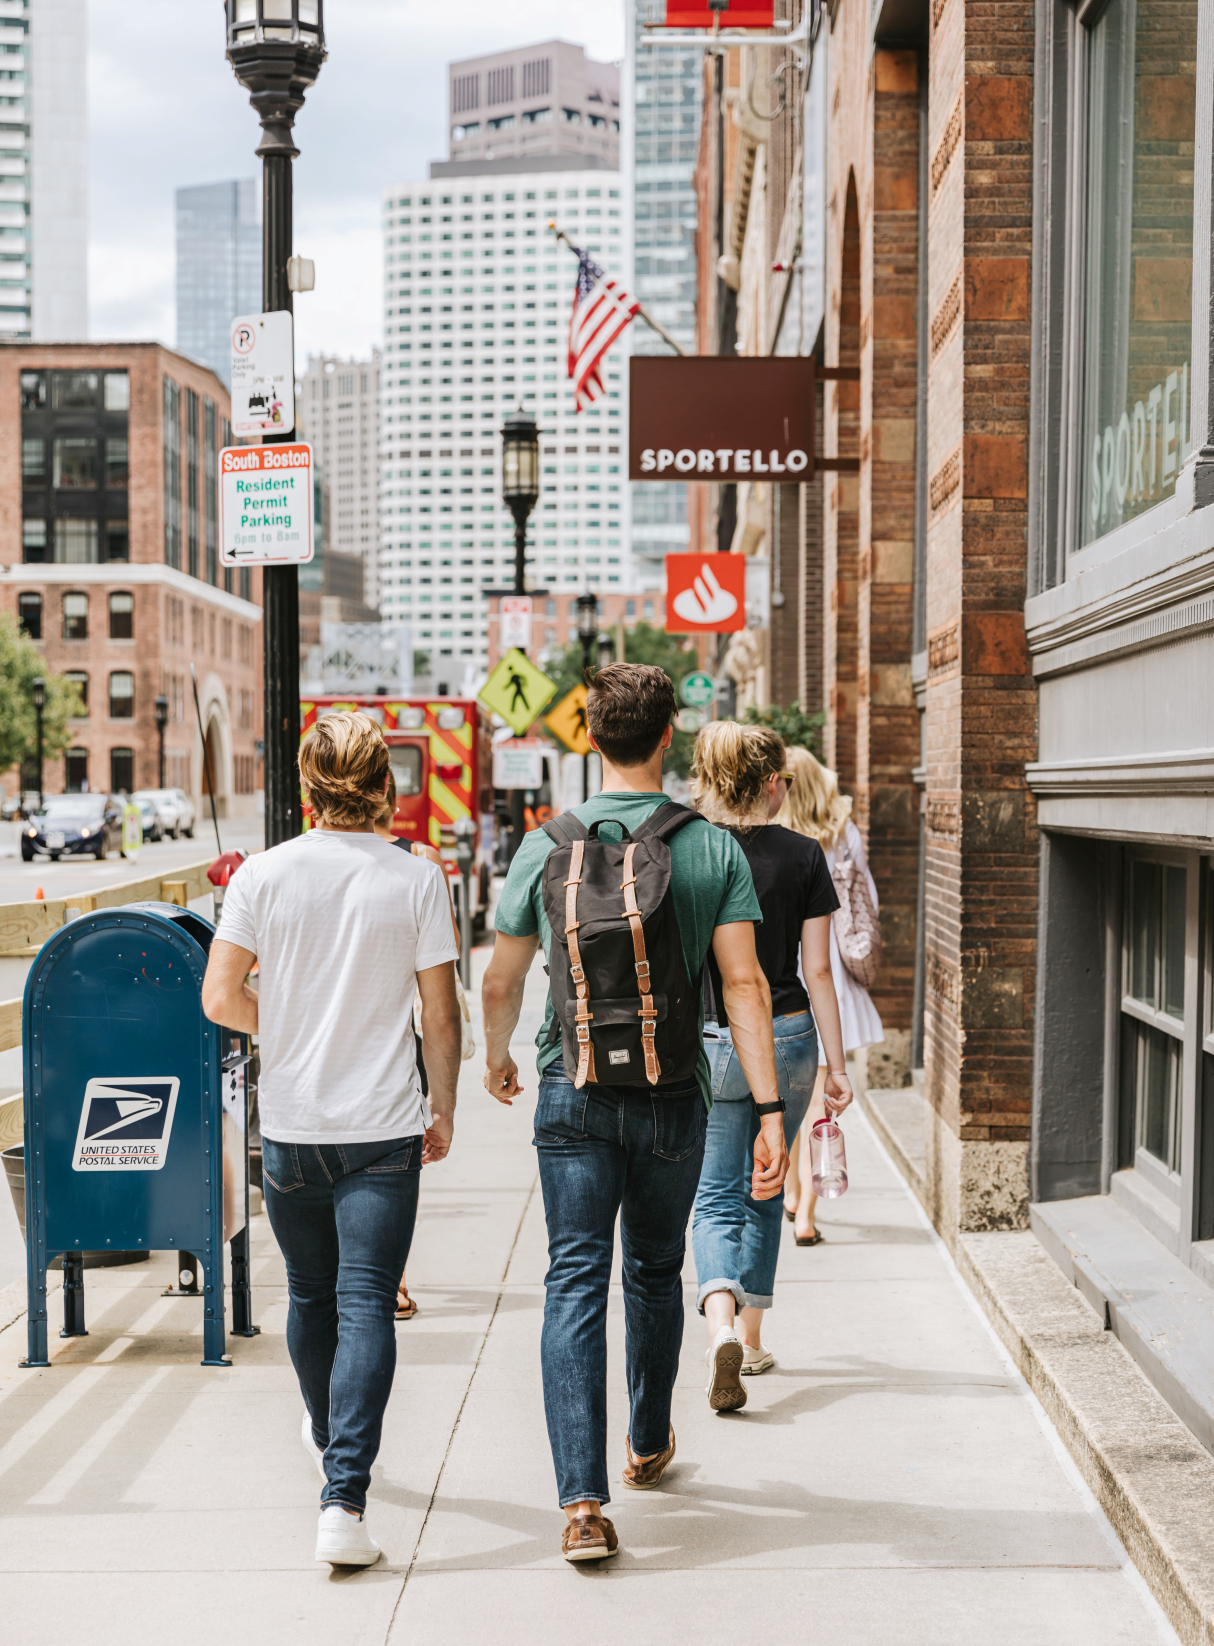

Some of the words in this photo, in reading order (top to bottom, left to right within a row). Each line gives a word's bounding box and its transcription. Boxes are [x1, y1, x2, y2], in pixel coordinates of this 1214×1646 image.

[232, 363, 256, 371] Parking
[232, 371, 246, 379] Only
[224, 451, 260, 471] South
[263, 450, 309, 468] Boston
[640, 449, 809, 473] SPORTELLO
[236, 477, 295, 493] Resident
[243, 495, 288, 510] Permit
[241, 512, 292, 528] Parking
[234, 533, 257, 545] 6pm
[261, 532, 272, 542] to
[277, 530, 300, 542] 8am
[80, 1145, 120, 1155] UNITED
[121, 1145, 156, 1154] STATES
[79, 1156, 116, 1166] POSTAL
[118, 1155, 159, 1165] SERVICE
